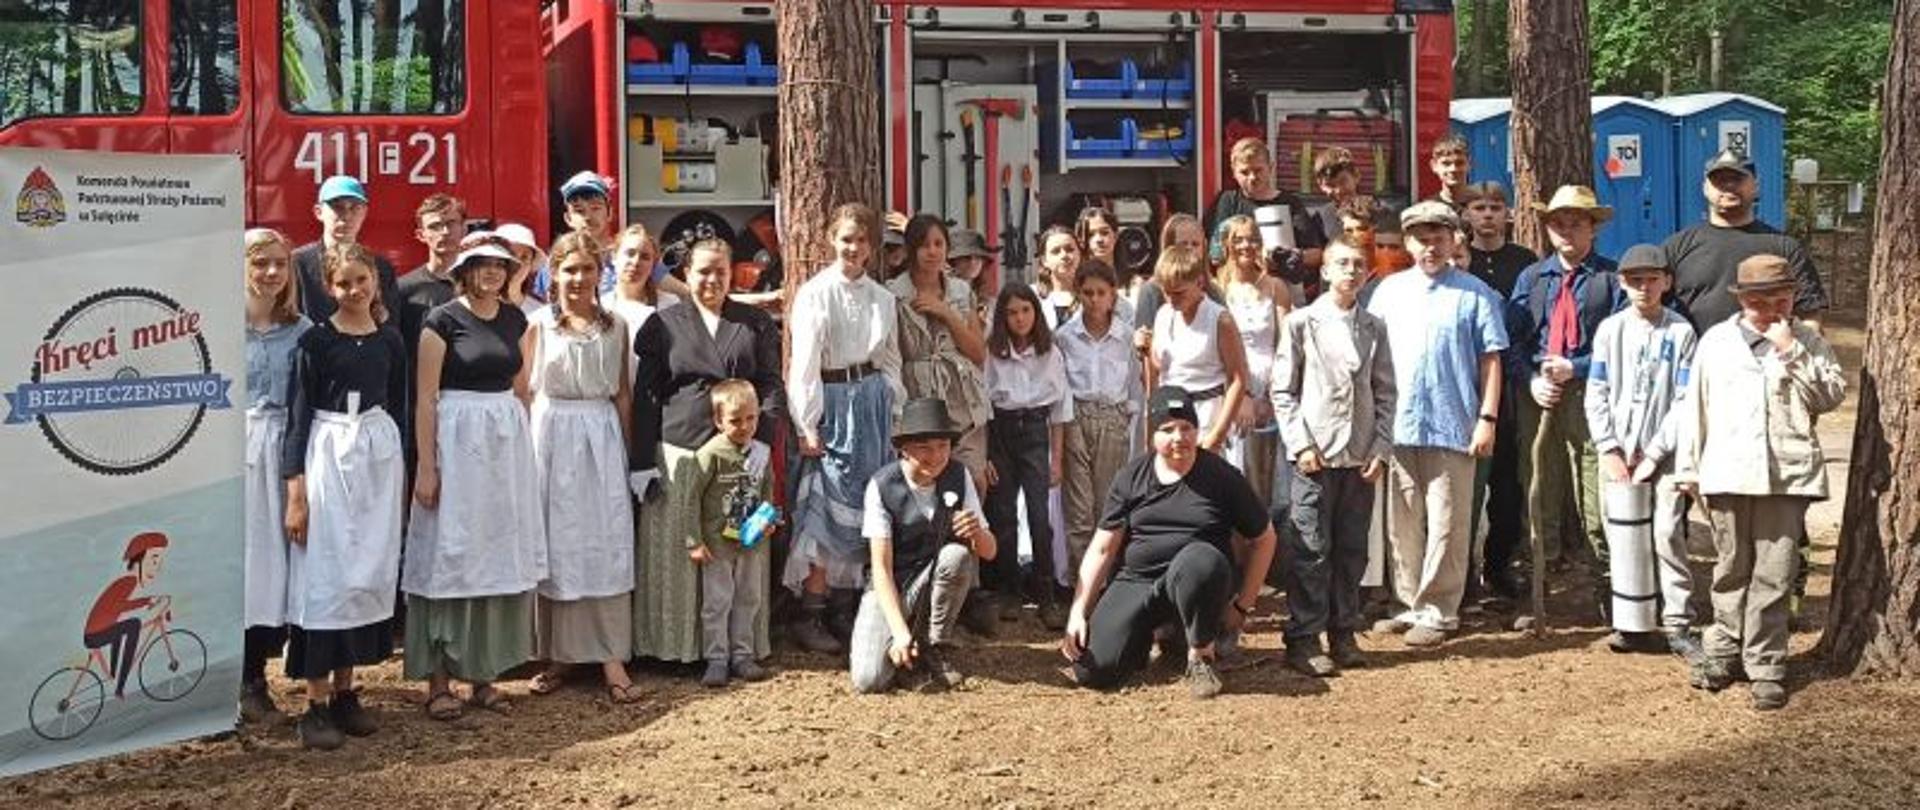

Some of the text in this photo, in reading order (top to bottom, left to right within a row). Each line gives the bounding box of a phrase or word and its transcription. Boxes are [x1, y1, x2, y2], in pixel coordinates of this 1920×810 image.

[294, 131, 457, 184] 411 F 21
[77, 175, 191, 189] Komenda Powiatowa
[78, 192, 226, 207] Państwowej Straży Pożarnej
[79, 209, 140, 224] w Sulęcinie
[36, 310, 200, 374] Kręci mnie
[28, 380, 219, 407] BEZPIECZEŃSTWO
